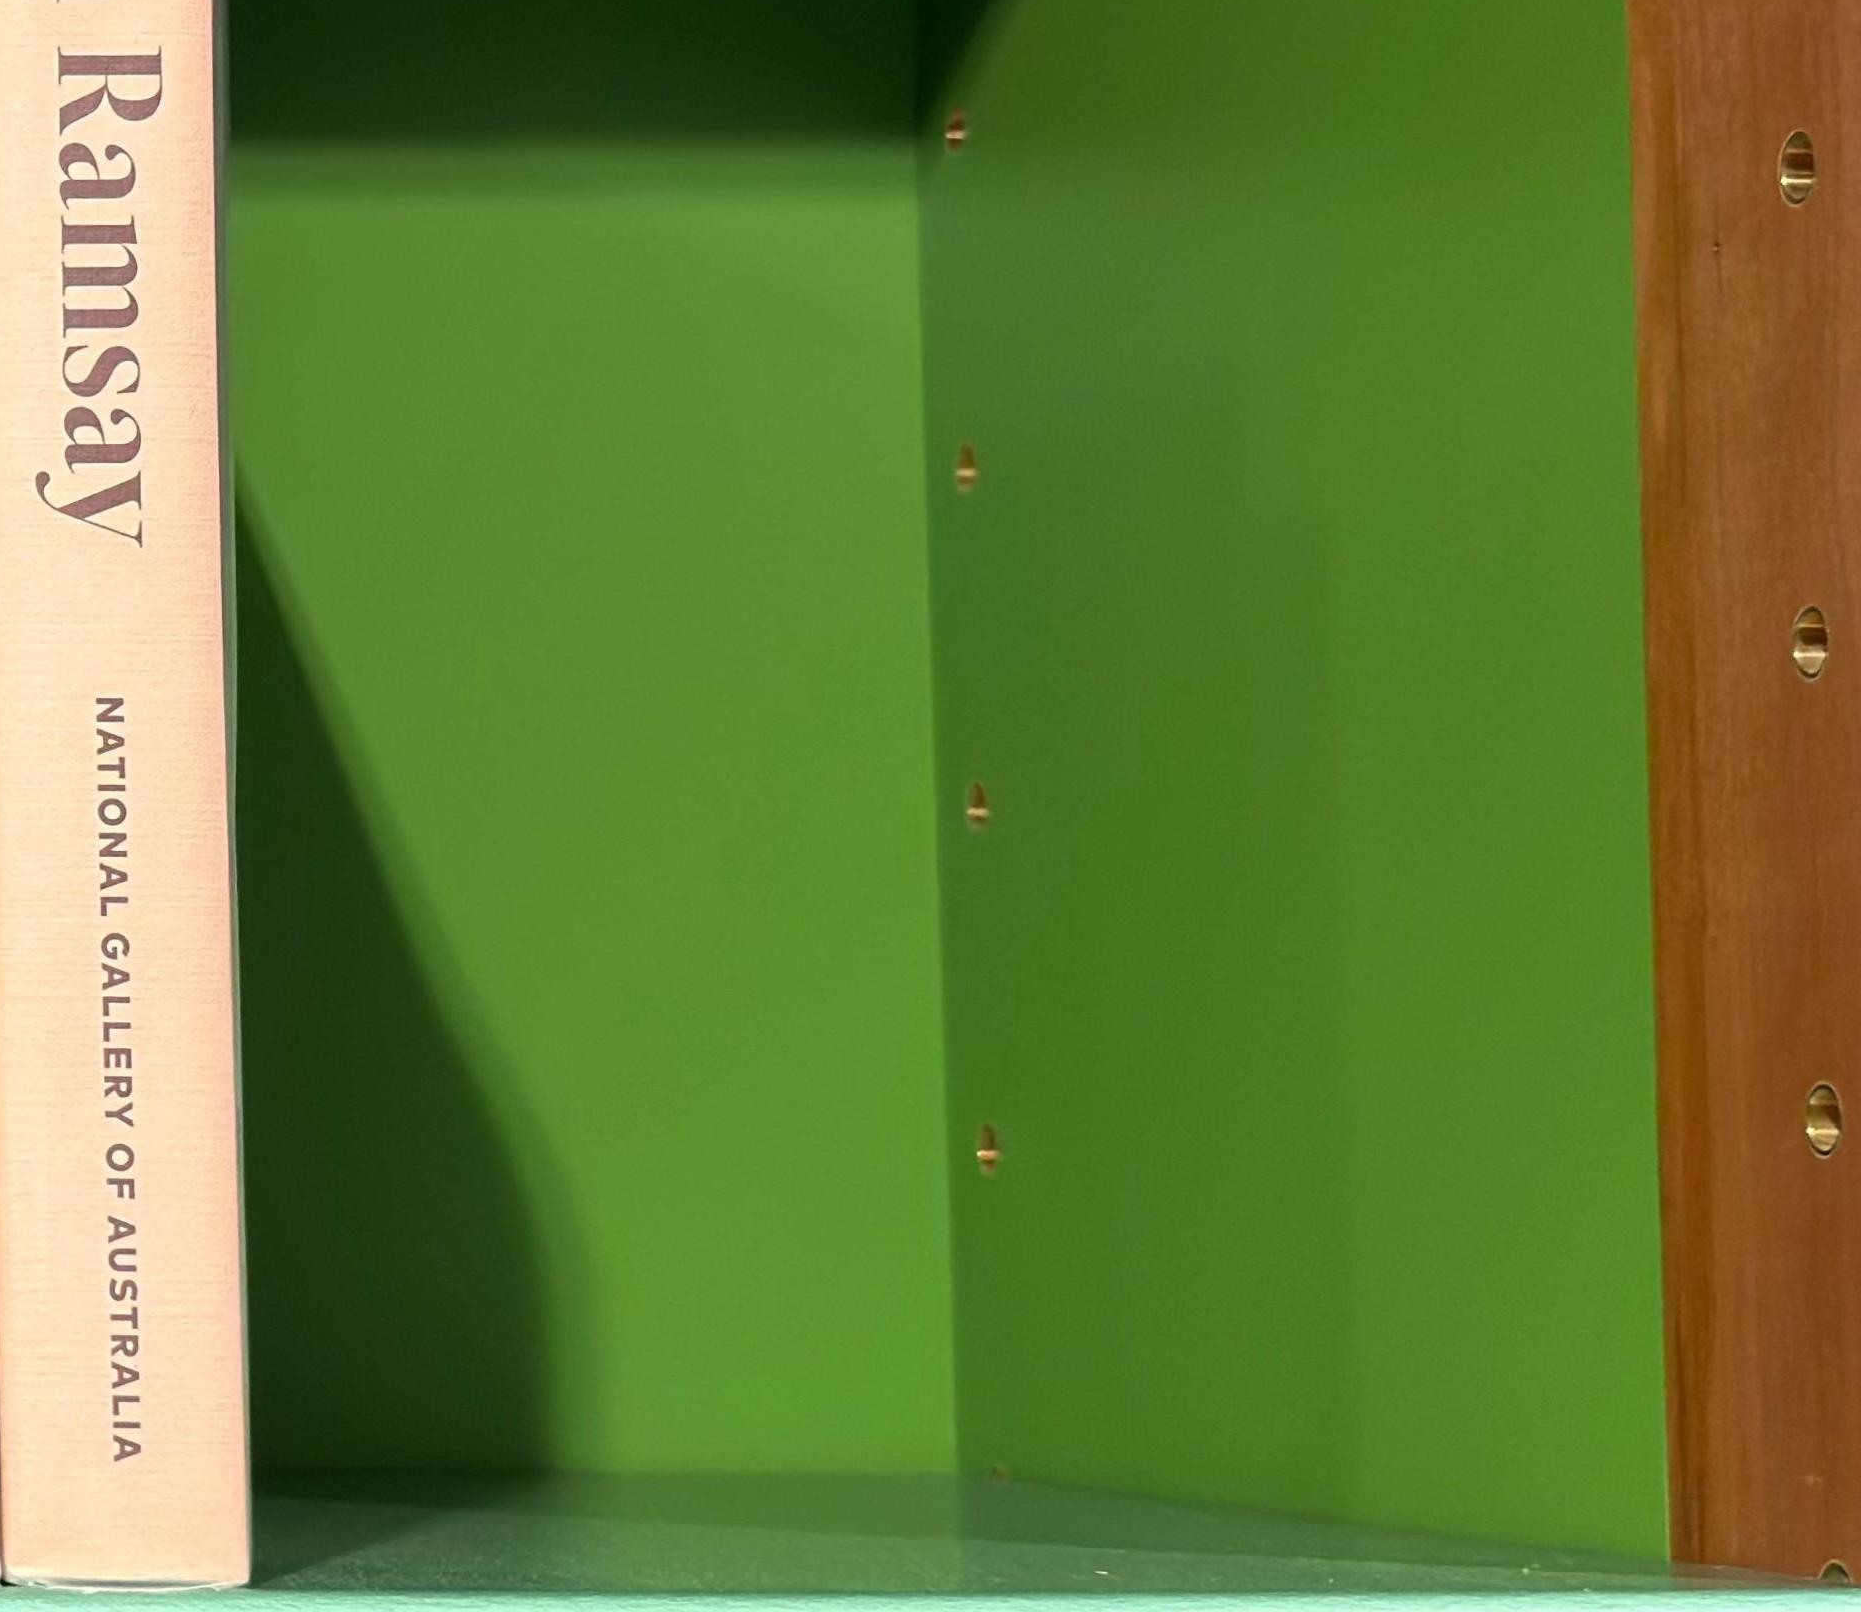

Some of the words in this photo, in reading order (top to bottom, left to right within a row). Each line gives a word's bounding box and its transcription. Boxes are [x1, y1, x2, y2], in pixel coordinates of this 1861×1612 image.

[33, 45, 163, 549] Ramsay
[94, 696, 129, 917] NATIONAL
[100, 932, 135, 1129] GALLERY
[105, 1143, 137, 1200] OF
[105, 1214, 143, 1463] AUSTRALIA
